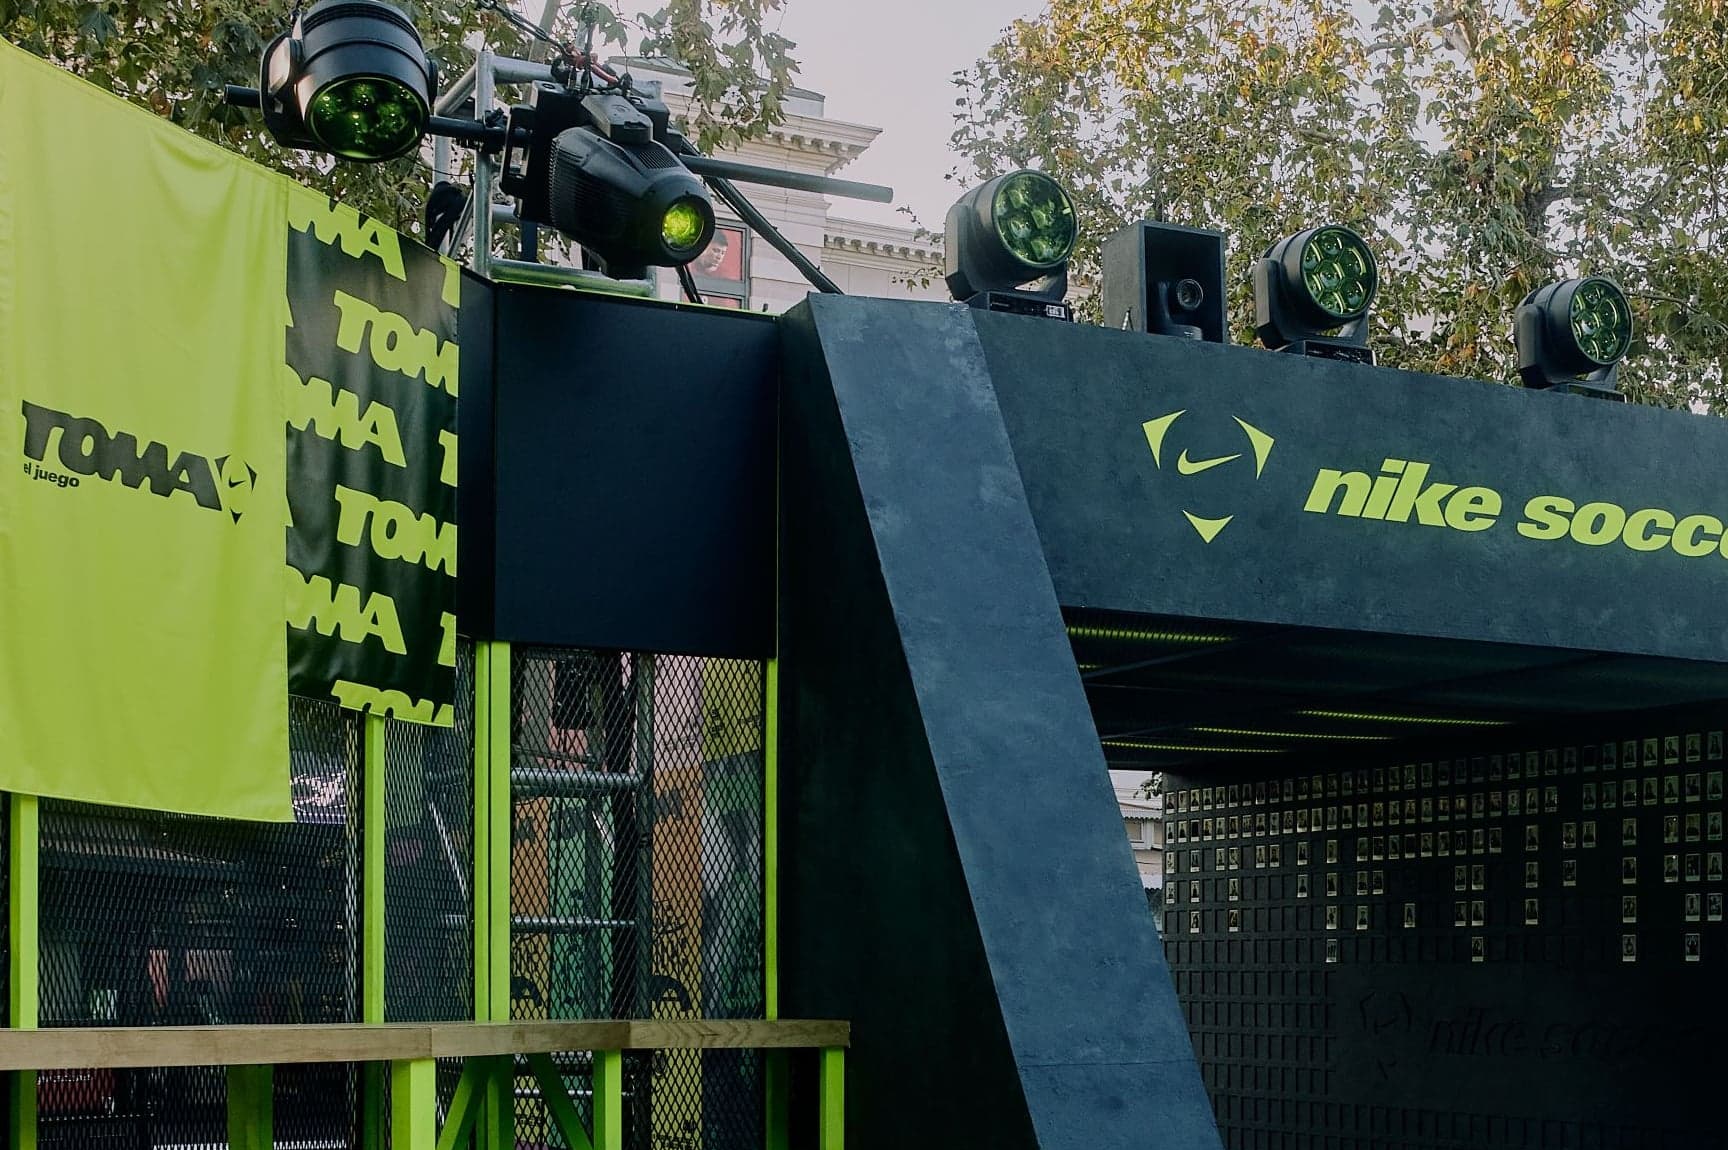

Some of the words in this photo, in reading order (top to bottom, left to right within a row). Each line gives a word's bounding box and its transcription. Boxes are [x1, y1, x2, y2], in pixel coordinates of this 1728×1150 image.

[22, 399, 222, 511] TOMA
[23, 461, 32, 475] el
[33, 464, 80, 488] juego
[1304, 458, 1502, 532] nike
